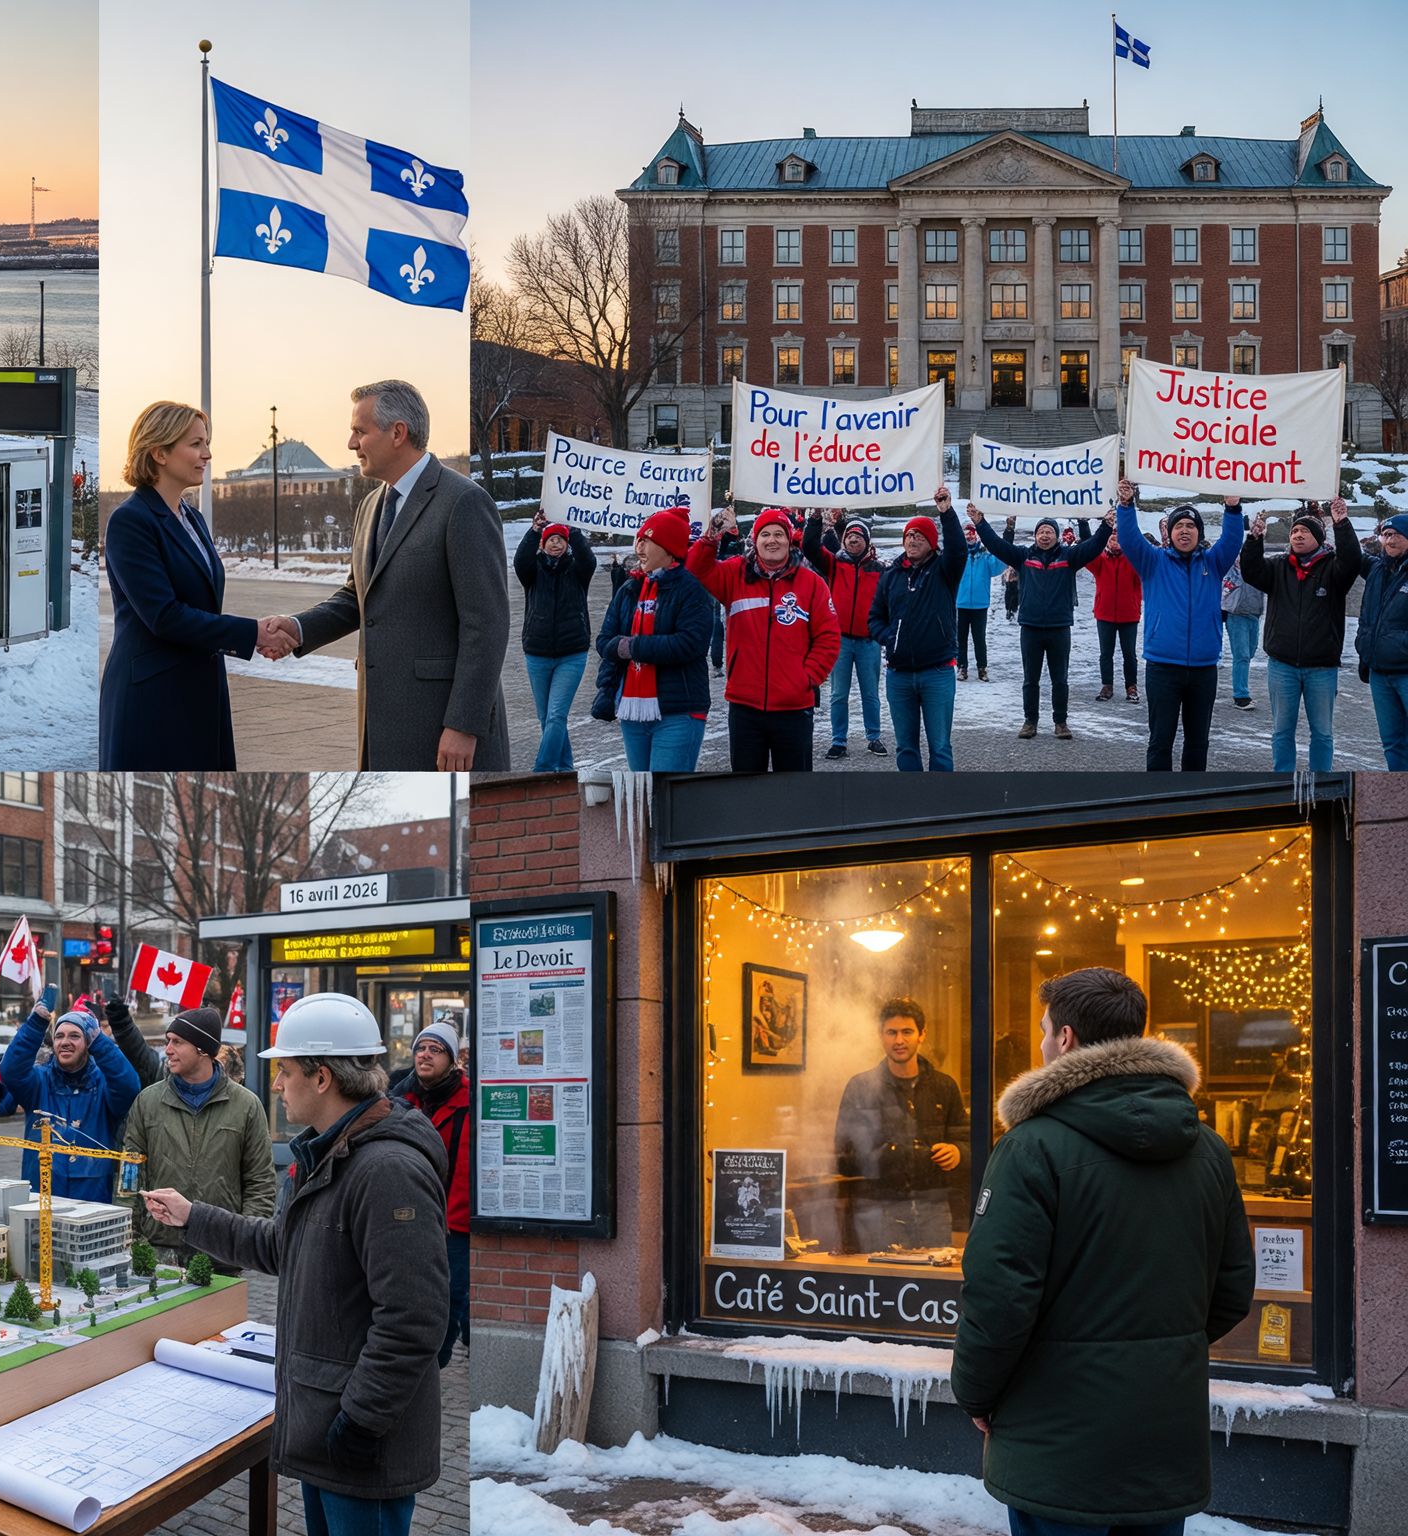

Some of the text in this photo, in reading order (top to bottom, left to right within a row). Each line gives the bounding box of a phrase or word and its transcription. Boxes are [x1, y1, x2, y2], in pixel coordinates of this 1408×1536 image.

[1155, 368, 1268, 411] Justice
[749, 389, 920, 431] Pour l'avenir
[750, 428, 881, 463] de l'éduce
[1172, 413, 1277, 447] sociale
[552, 438, 626, 476] Pource
[1137, 446, 1304, 484] maintenant
[772, 461, 915, 495] l'éducation
[289, 882, 379, 904] 16 avril 2026
[493, 948, 574, 970] Le Devoir
[714, 1271, 959, 1325] Café Saint-Cas
